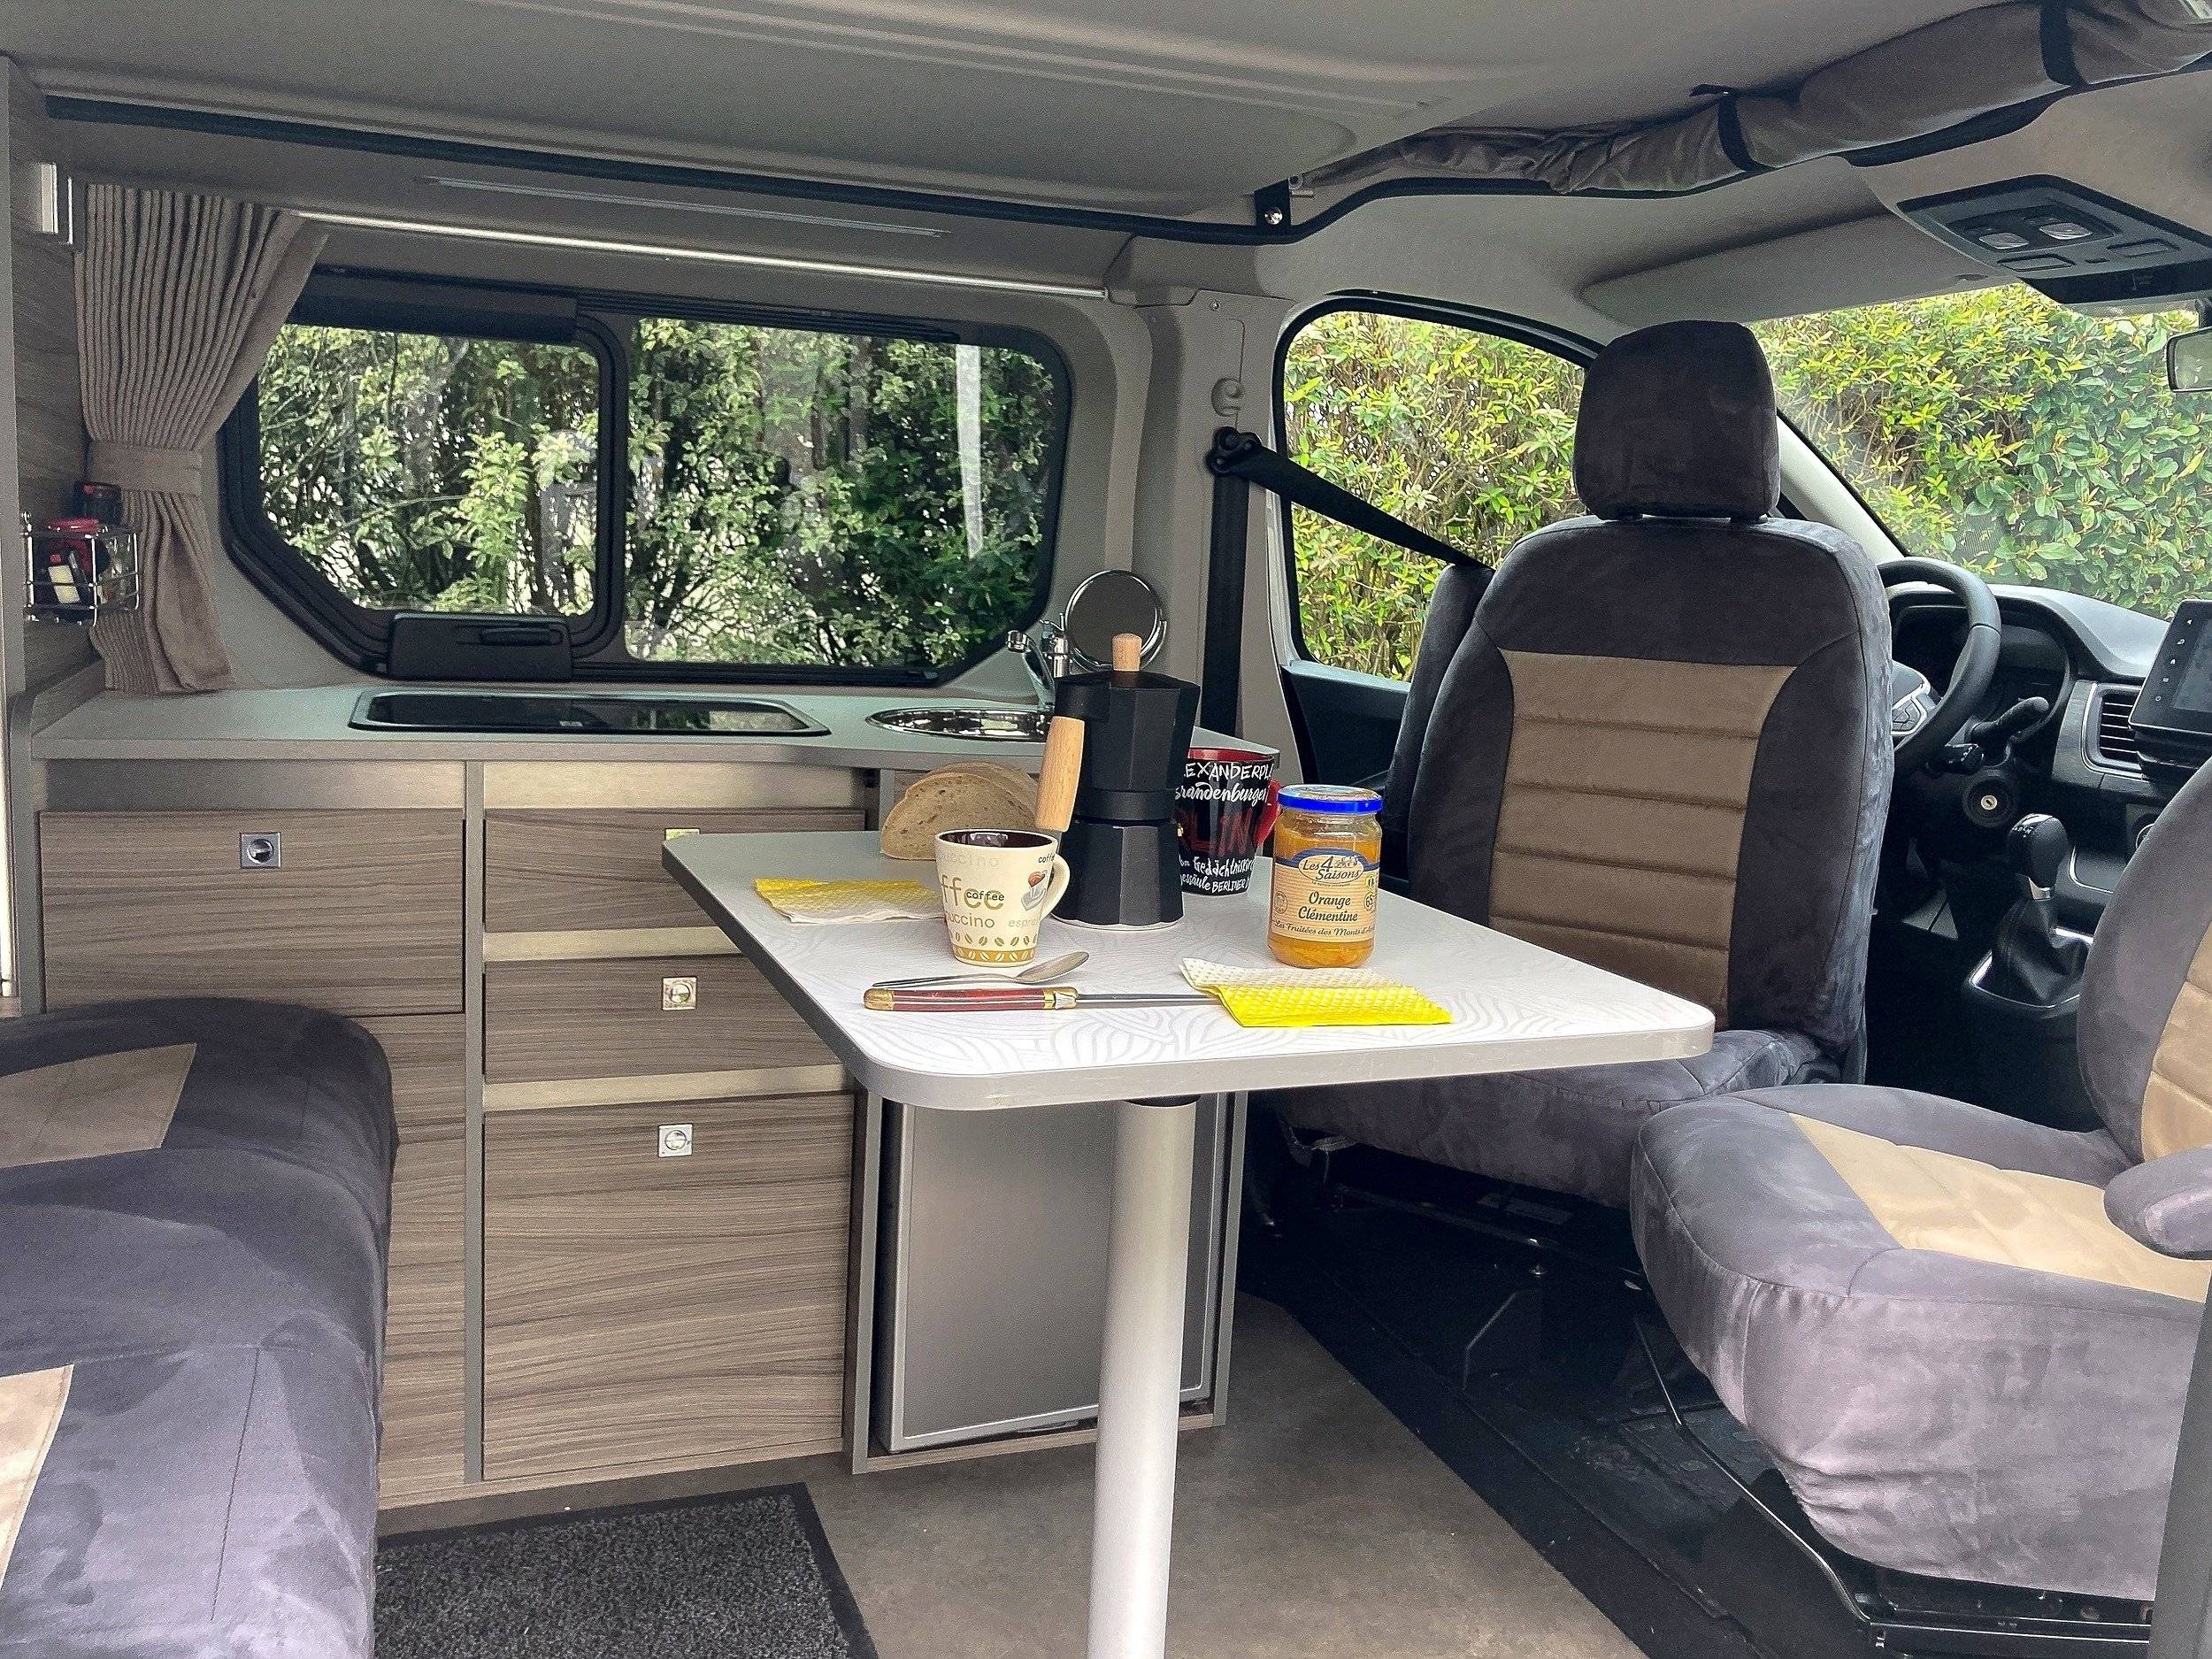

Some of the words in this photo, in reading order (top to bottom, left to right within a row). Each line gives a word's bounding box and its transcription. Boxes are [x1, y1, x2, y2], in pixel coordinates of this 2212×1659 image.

[1302, 859, 1319, 871] Les
[1321, 856, 1334, 872] 4
[1315, 868, 1360, 880] Saisons
[965, 890, 1005, 902] coffee
[1309, 891, 1351, 910] Orange
[1298, 906, 1358, 922] Clémentine
[1274, 919, 1285, 929] Les
[1286, 923, 1317, 935] Fruitées
[1317, 927, 1331, 936] des
[1333, 927, 1361, 936] Monts
